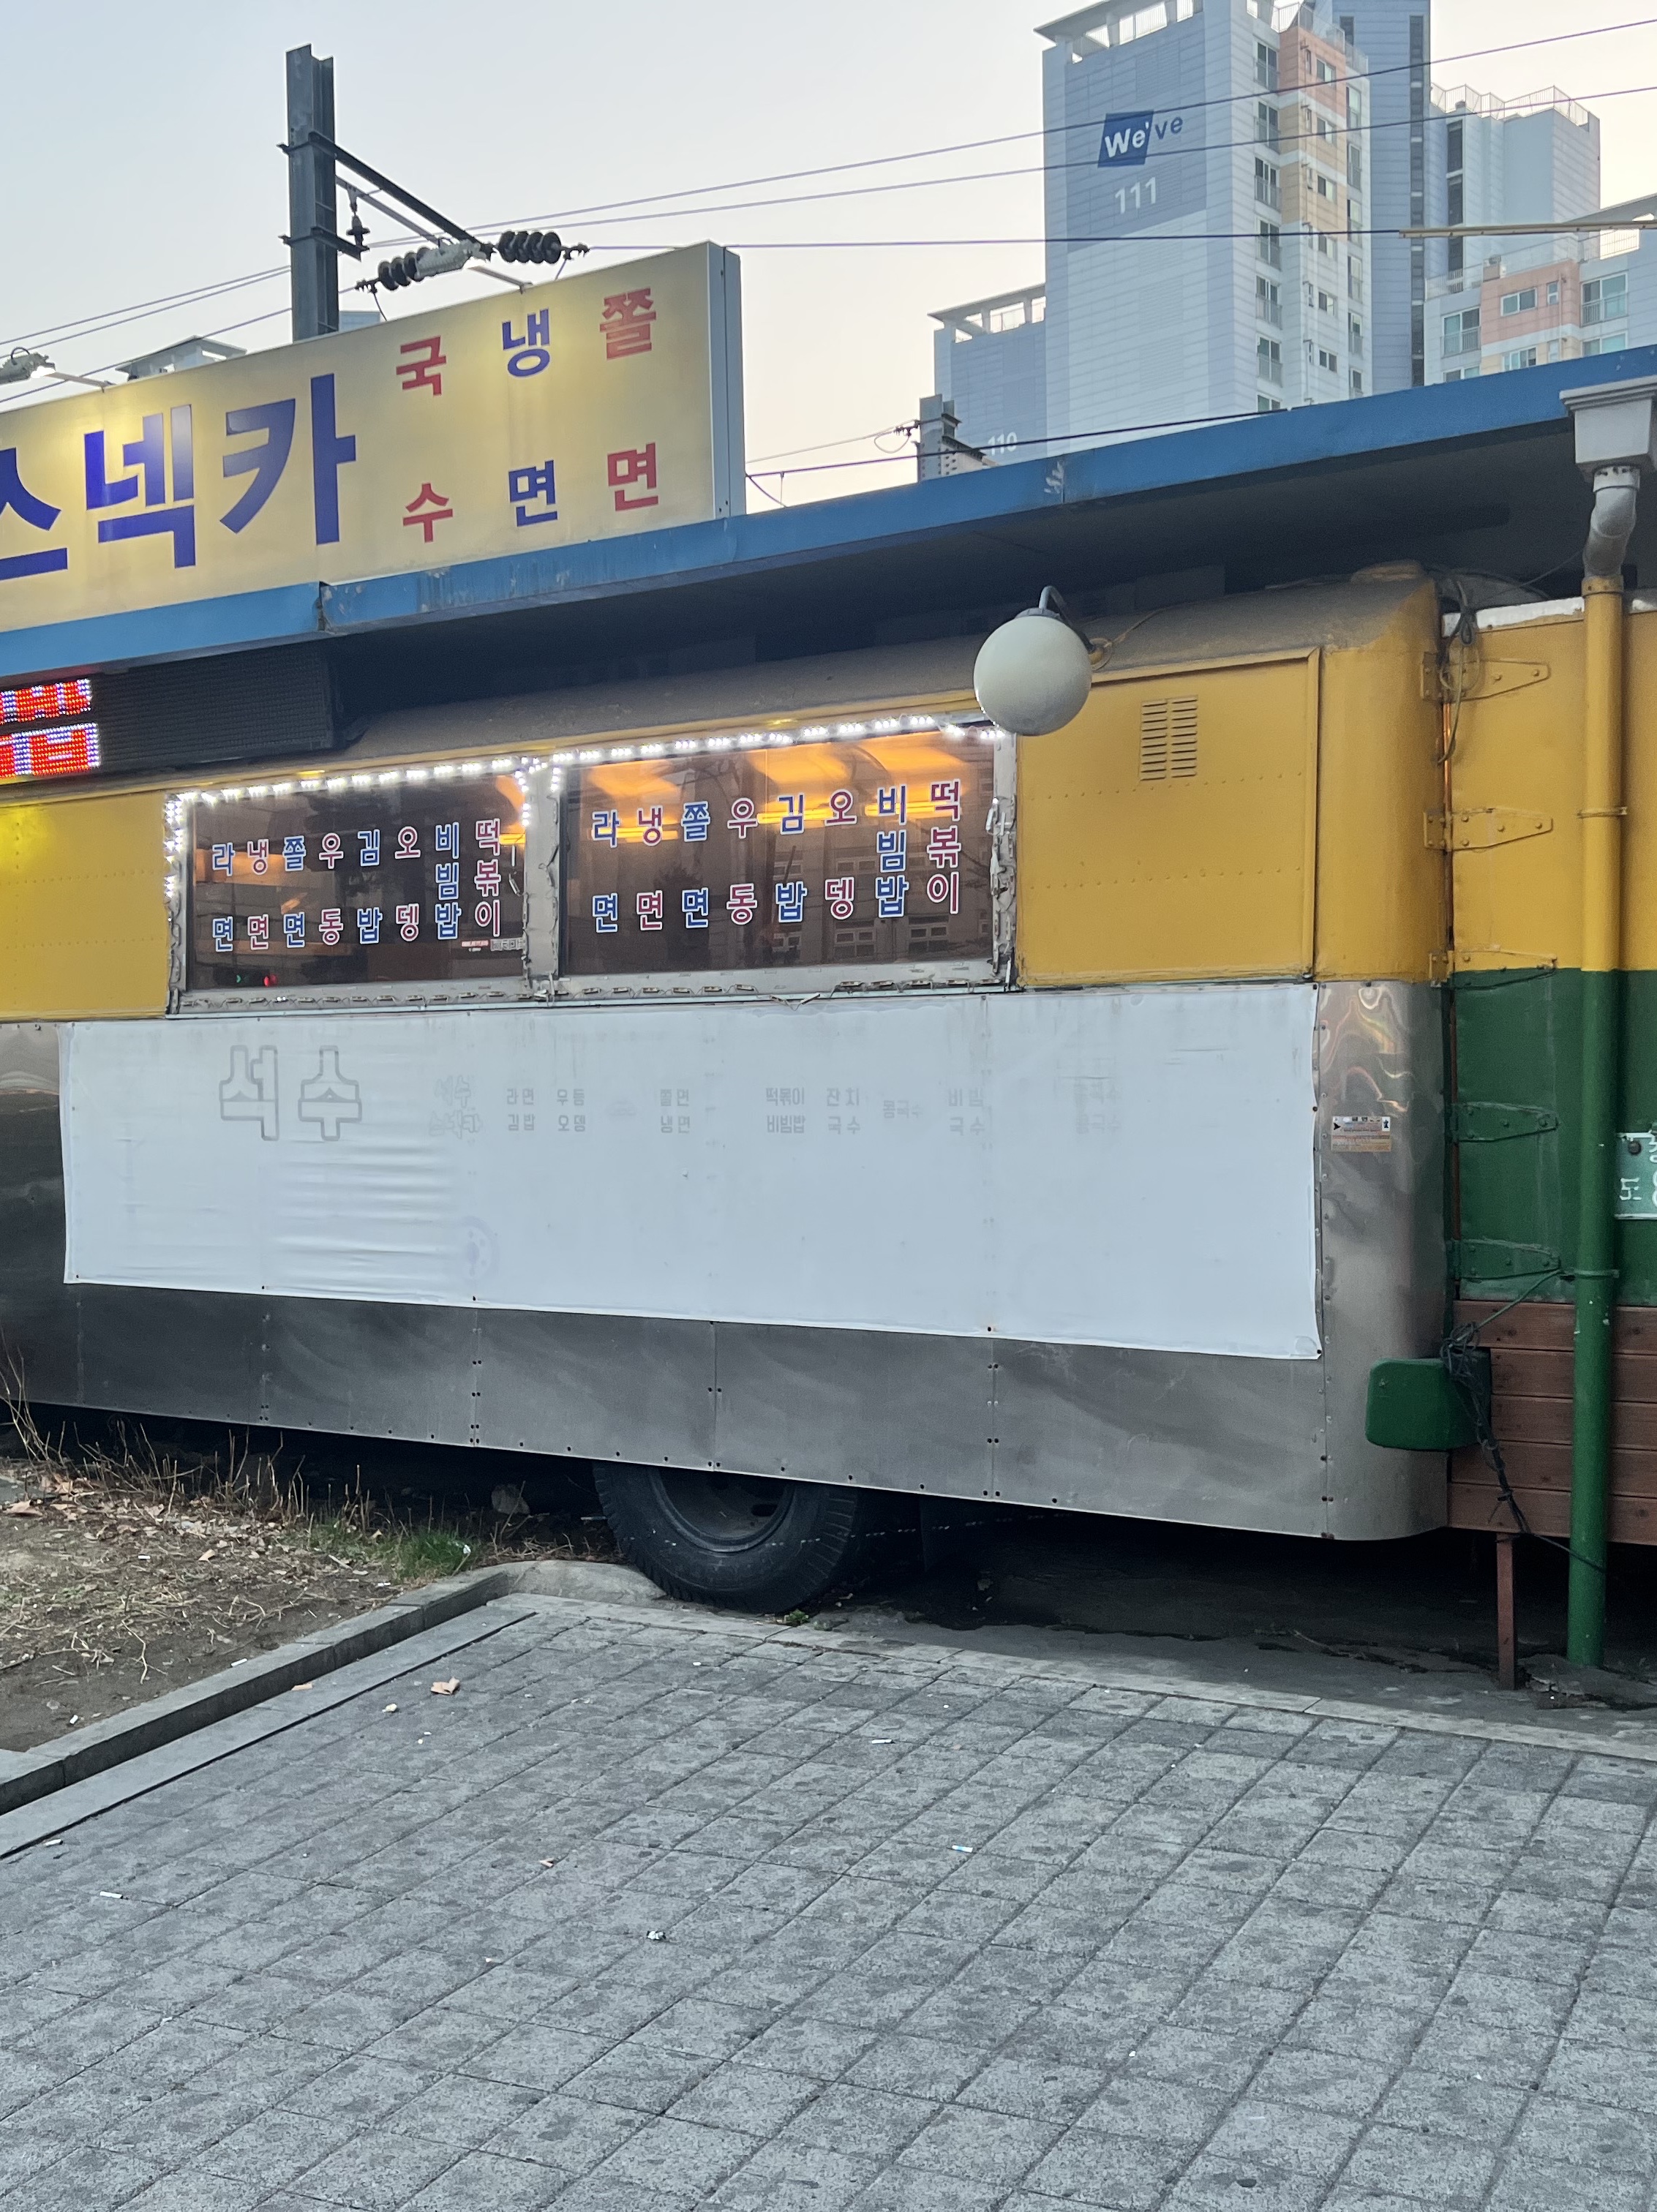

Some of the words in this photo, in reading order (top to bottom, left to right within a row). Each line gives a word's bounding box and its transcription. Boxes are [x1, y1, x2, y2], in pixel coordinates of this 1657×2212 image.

[1105, 116, 1183, 158] We've
[1115, 177, 1156, 214] 111
[396, 336, 453, 542] 국수
[502, 309, 558, 527] 냉면
[599, 287, 658, 512] 쫄면
[988, 432, 1018, 456] 110
[212, 843, 235, 952] 라면
[247, 839, 269, 949] 냉면
[282, 835, 307, 948] 쫄면
[318, 832, 344, 946] 우동
[357, 829, 382, 944] 김밥
[394, 826, 421, 942] 오뎅
[435, 821, 462, 940] 비빔밥
[474, 818, 501, 938] 떡볶이
[592, 809, 620, 933] 라면
[636, 806, 664, 930] 냉면
[680, 801, 711, 928] 쫄면
[726, 797, 758, 925] 우동
[775, 793, 808, 923] 김밥
[824, 789, 857, 920] 오뎅
[875, 784, 909, 919] 비빔밥
[927, 778, 961, 915] 떡볶이
[219, 1045, 362, 1142] 석수
[507, 1088, 533, 1105] 라면
[508, 1113, 536, 1131] 김밥
[558, 1115, 585, 1132] 오뎅
[661, 1116, 690, 1133] 냉면
[766, 1088, 805, 1106] 떡볶이
[767, 1115, 805, 1134] 비빔밥
[826, 1088, 860, 1107] 잔치
[828, 1116, 861, 1135] 국수
[950, 1116, 985, 1136] 국수
